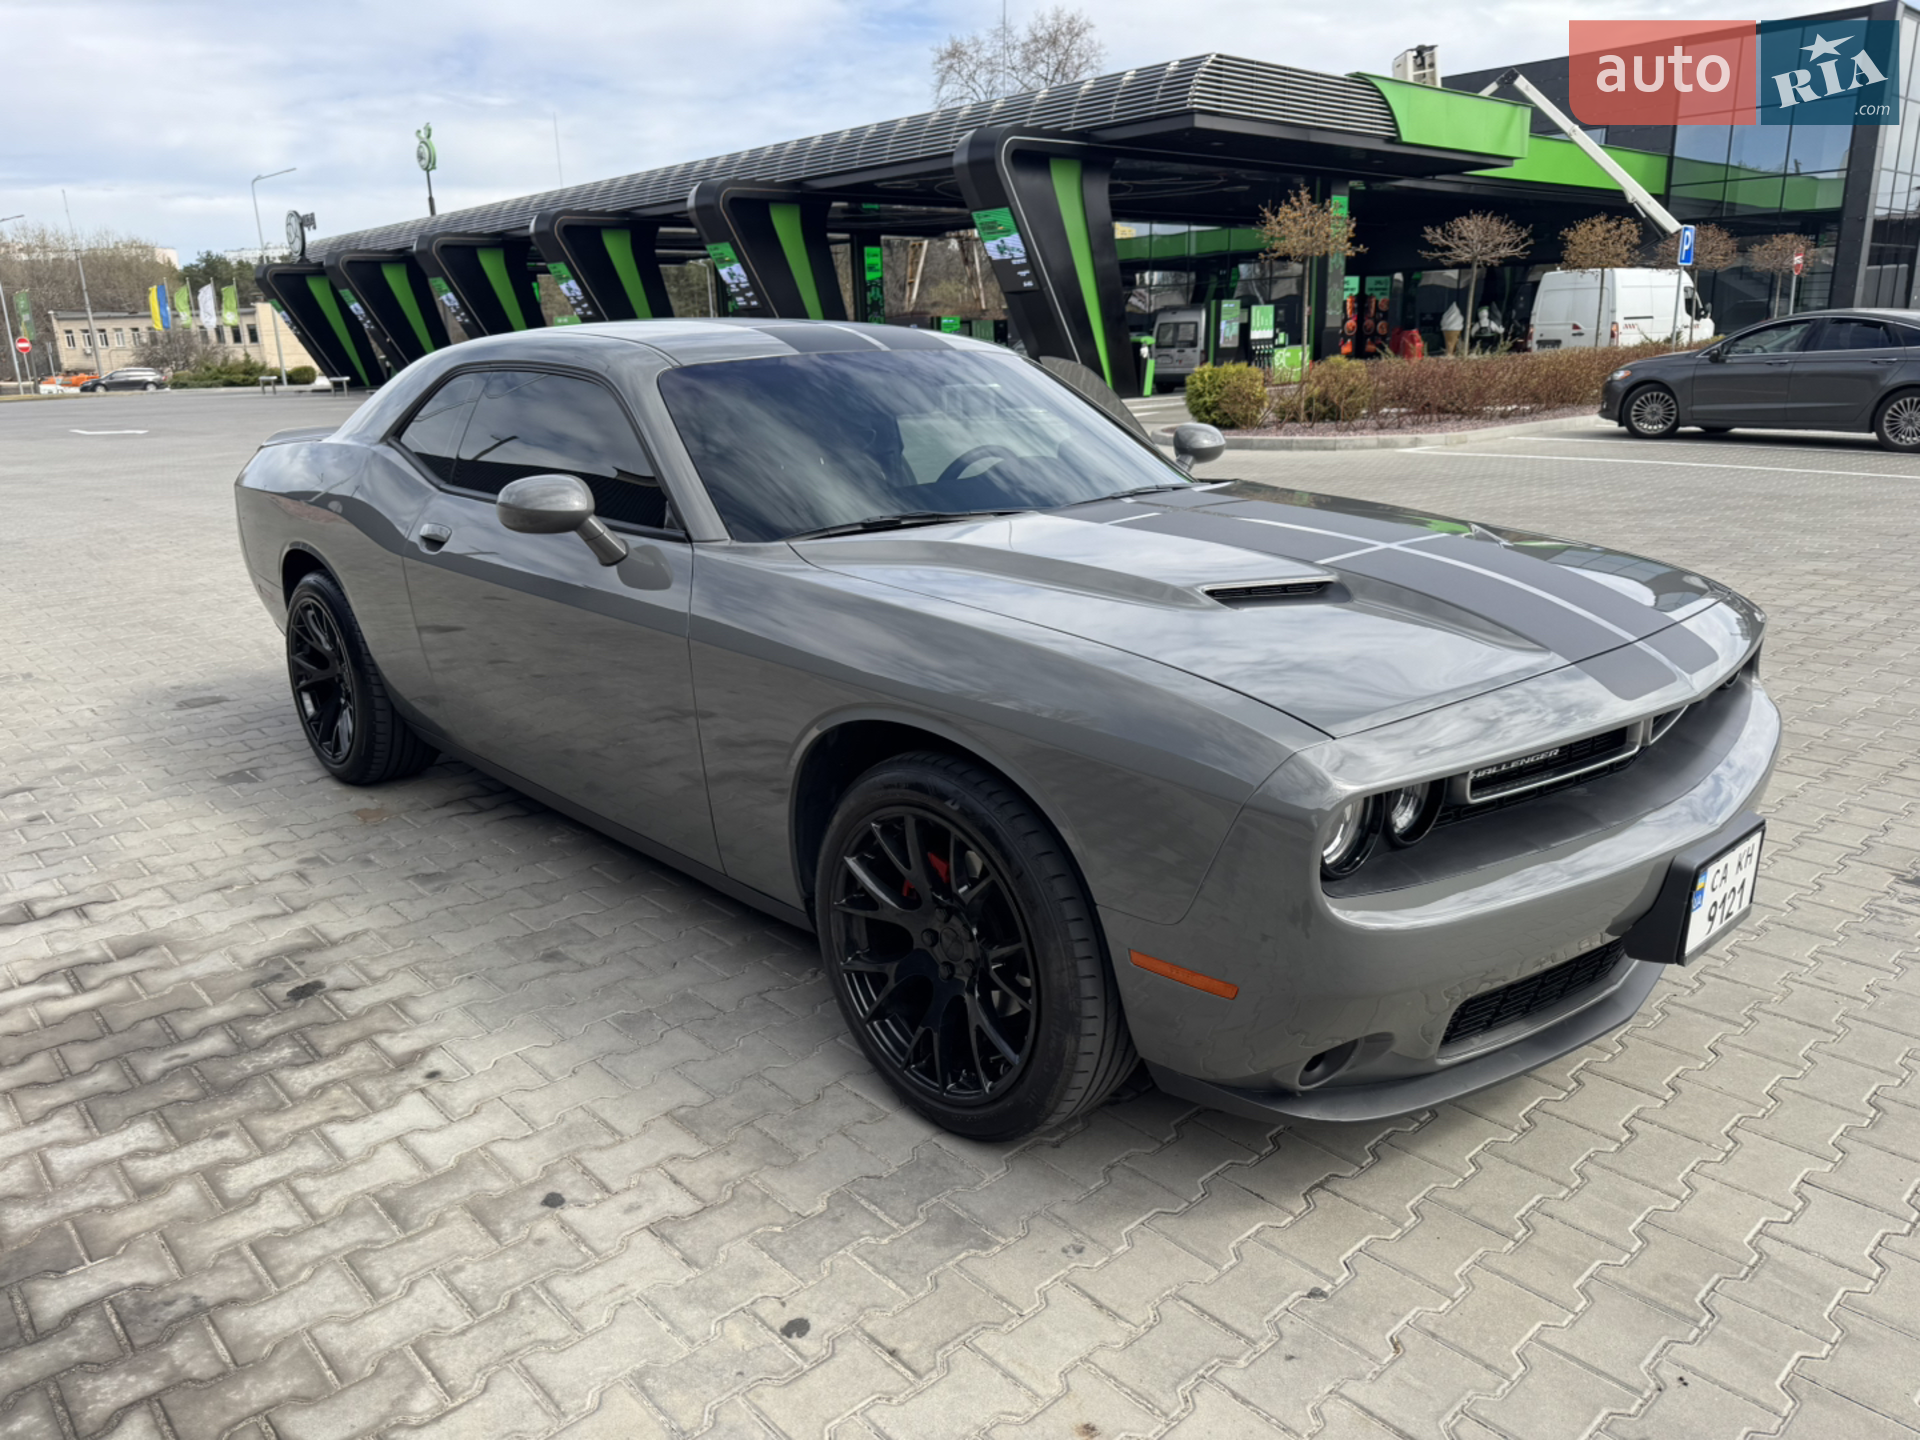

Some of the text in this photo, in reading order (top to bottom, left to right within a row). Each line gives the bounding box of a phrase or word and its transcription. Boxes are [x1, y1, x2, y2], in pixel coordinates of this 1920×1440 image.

[1681, 231, 1692, 260] P
[1469, 748, 1560, 779] HALLENGER
[1710, 843, 1756, 893] CA KH
[1706, 877, 1747, 936] 9121
